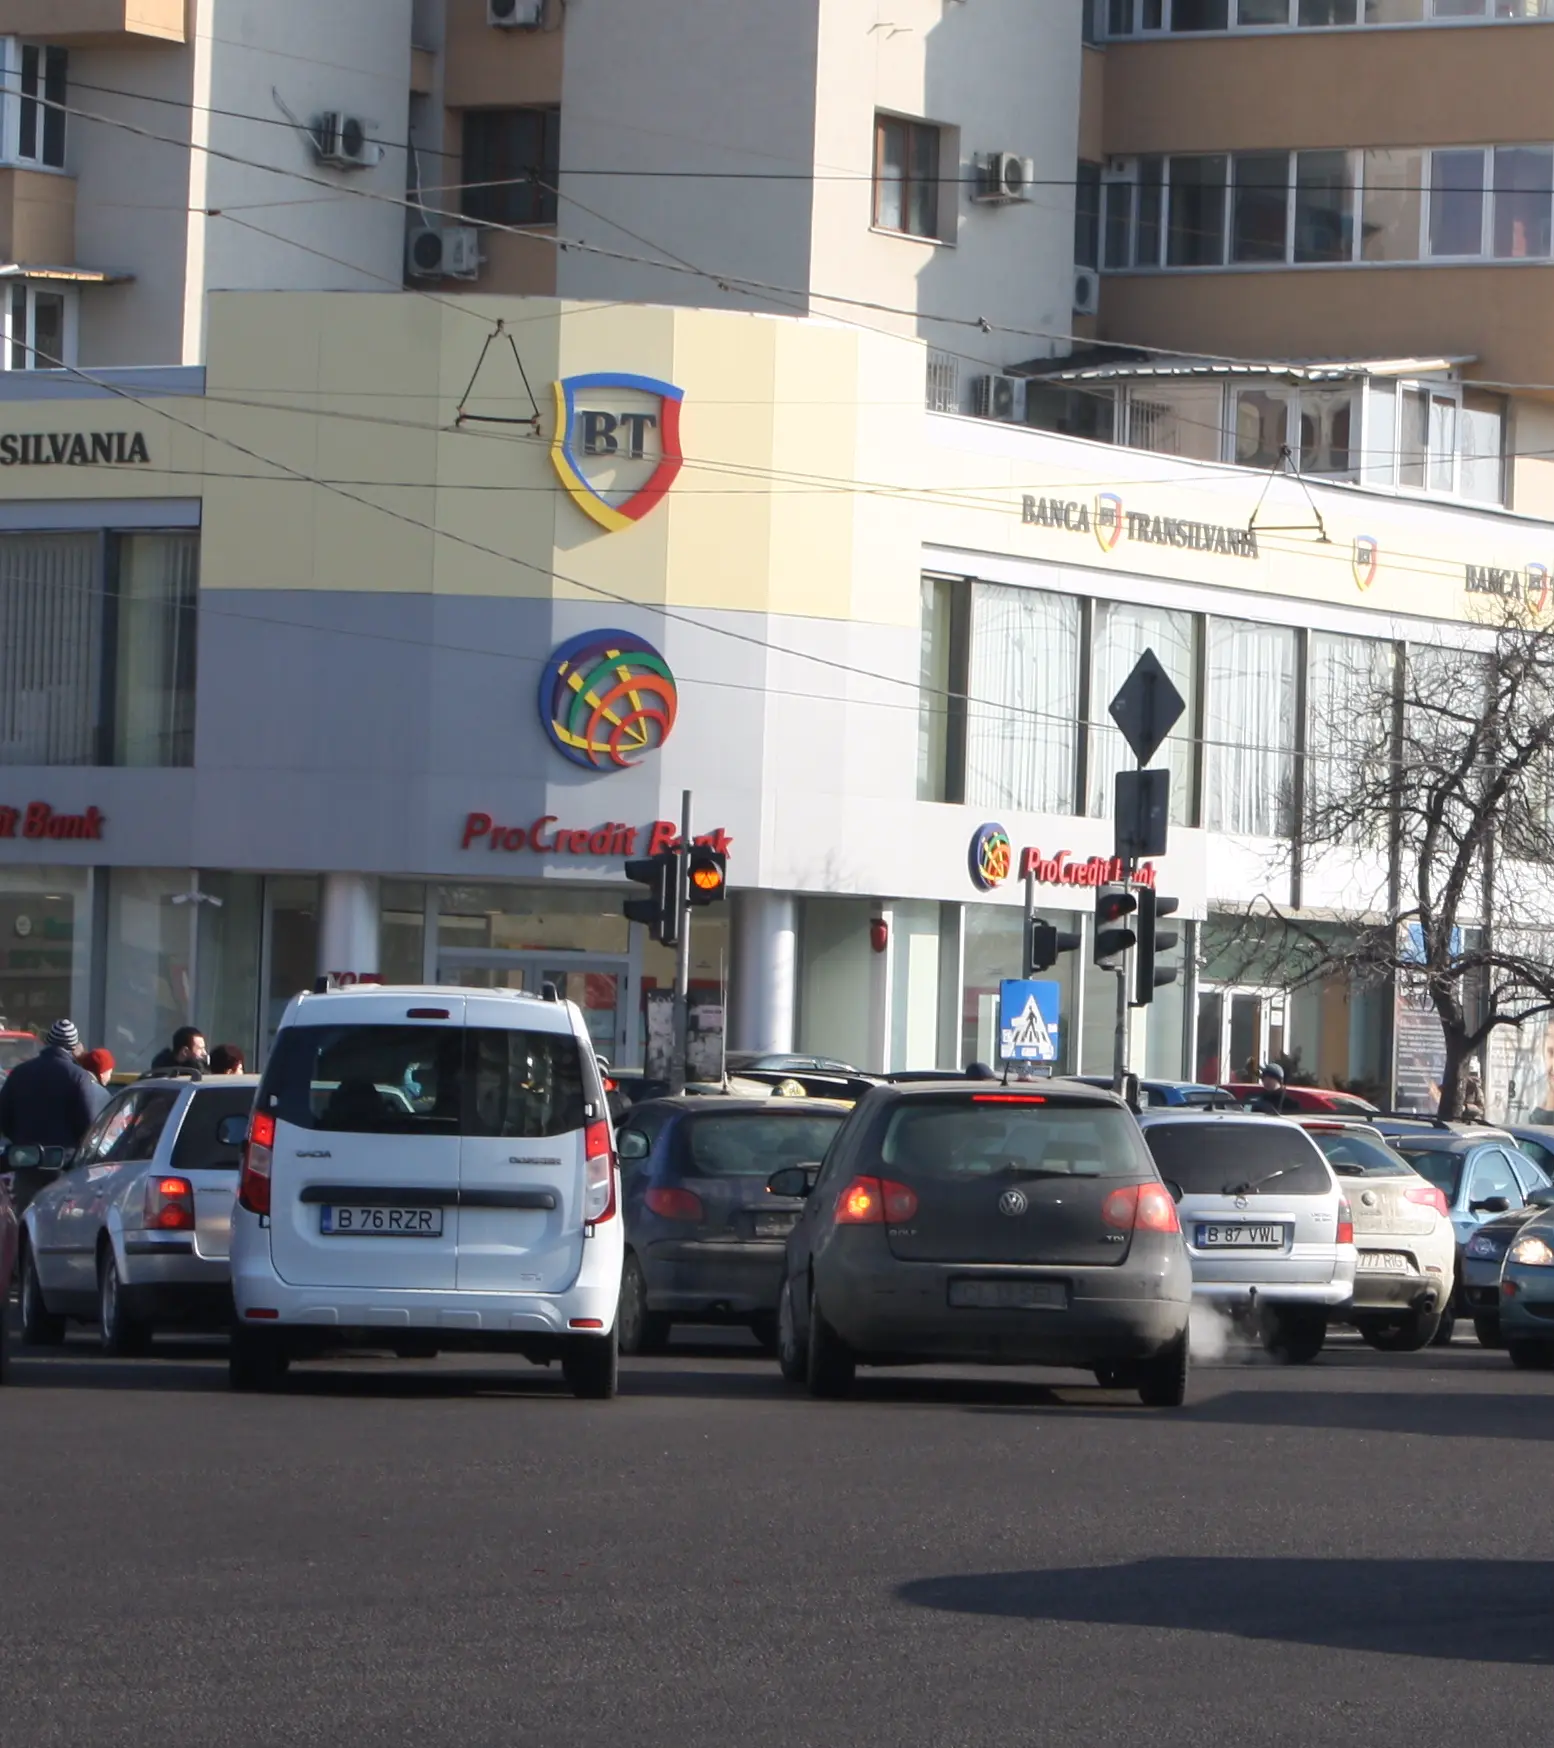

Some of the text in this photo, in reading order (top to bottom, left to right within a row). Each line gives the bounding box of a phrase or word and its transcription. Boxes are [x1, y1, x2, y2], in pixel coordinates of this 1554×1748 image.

[580, 409, 656, 459] BT
[1021, 494, 1090, 533] BANCA
[1125, 511, 1260, 559] TRANSILVANIA
[22, 801, 106, 840] Bank
[461, 812, 638, 857] ProCredit
[1018, 846, 1111, 887] ProCredit
[338, 1209, 433, 1230] B 76 RZR
[1207, 1225, 1280, 1243] B 87 VWL
